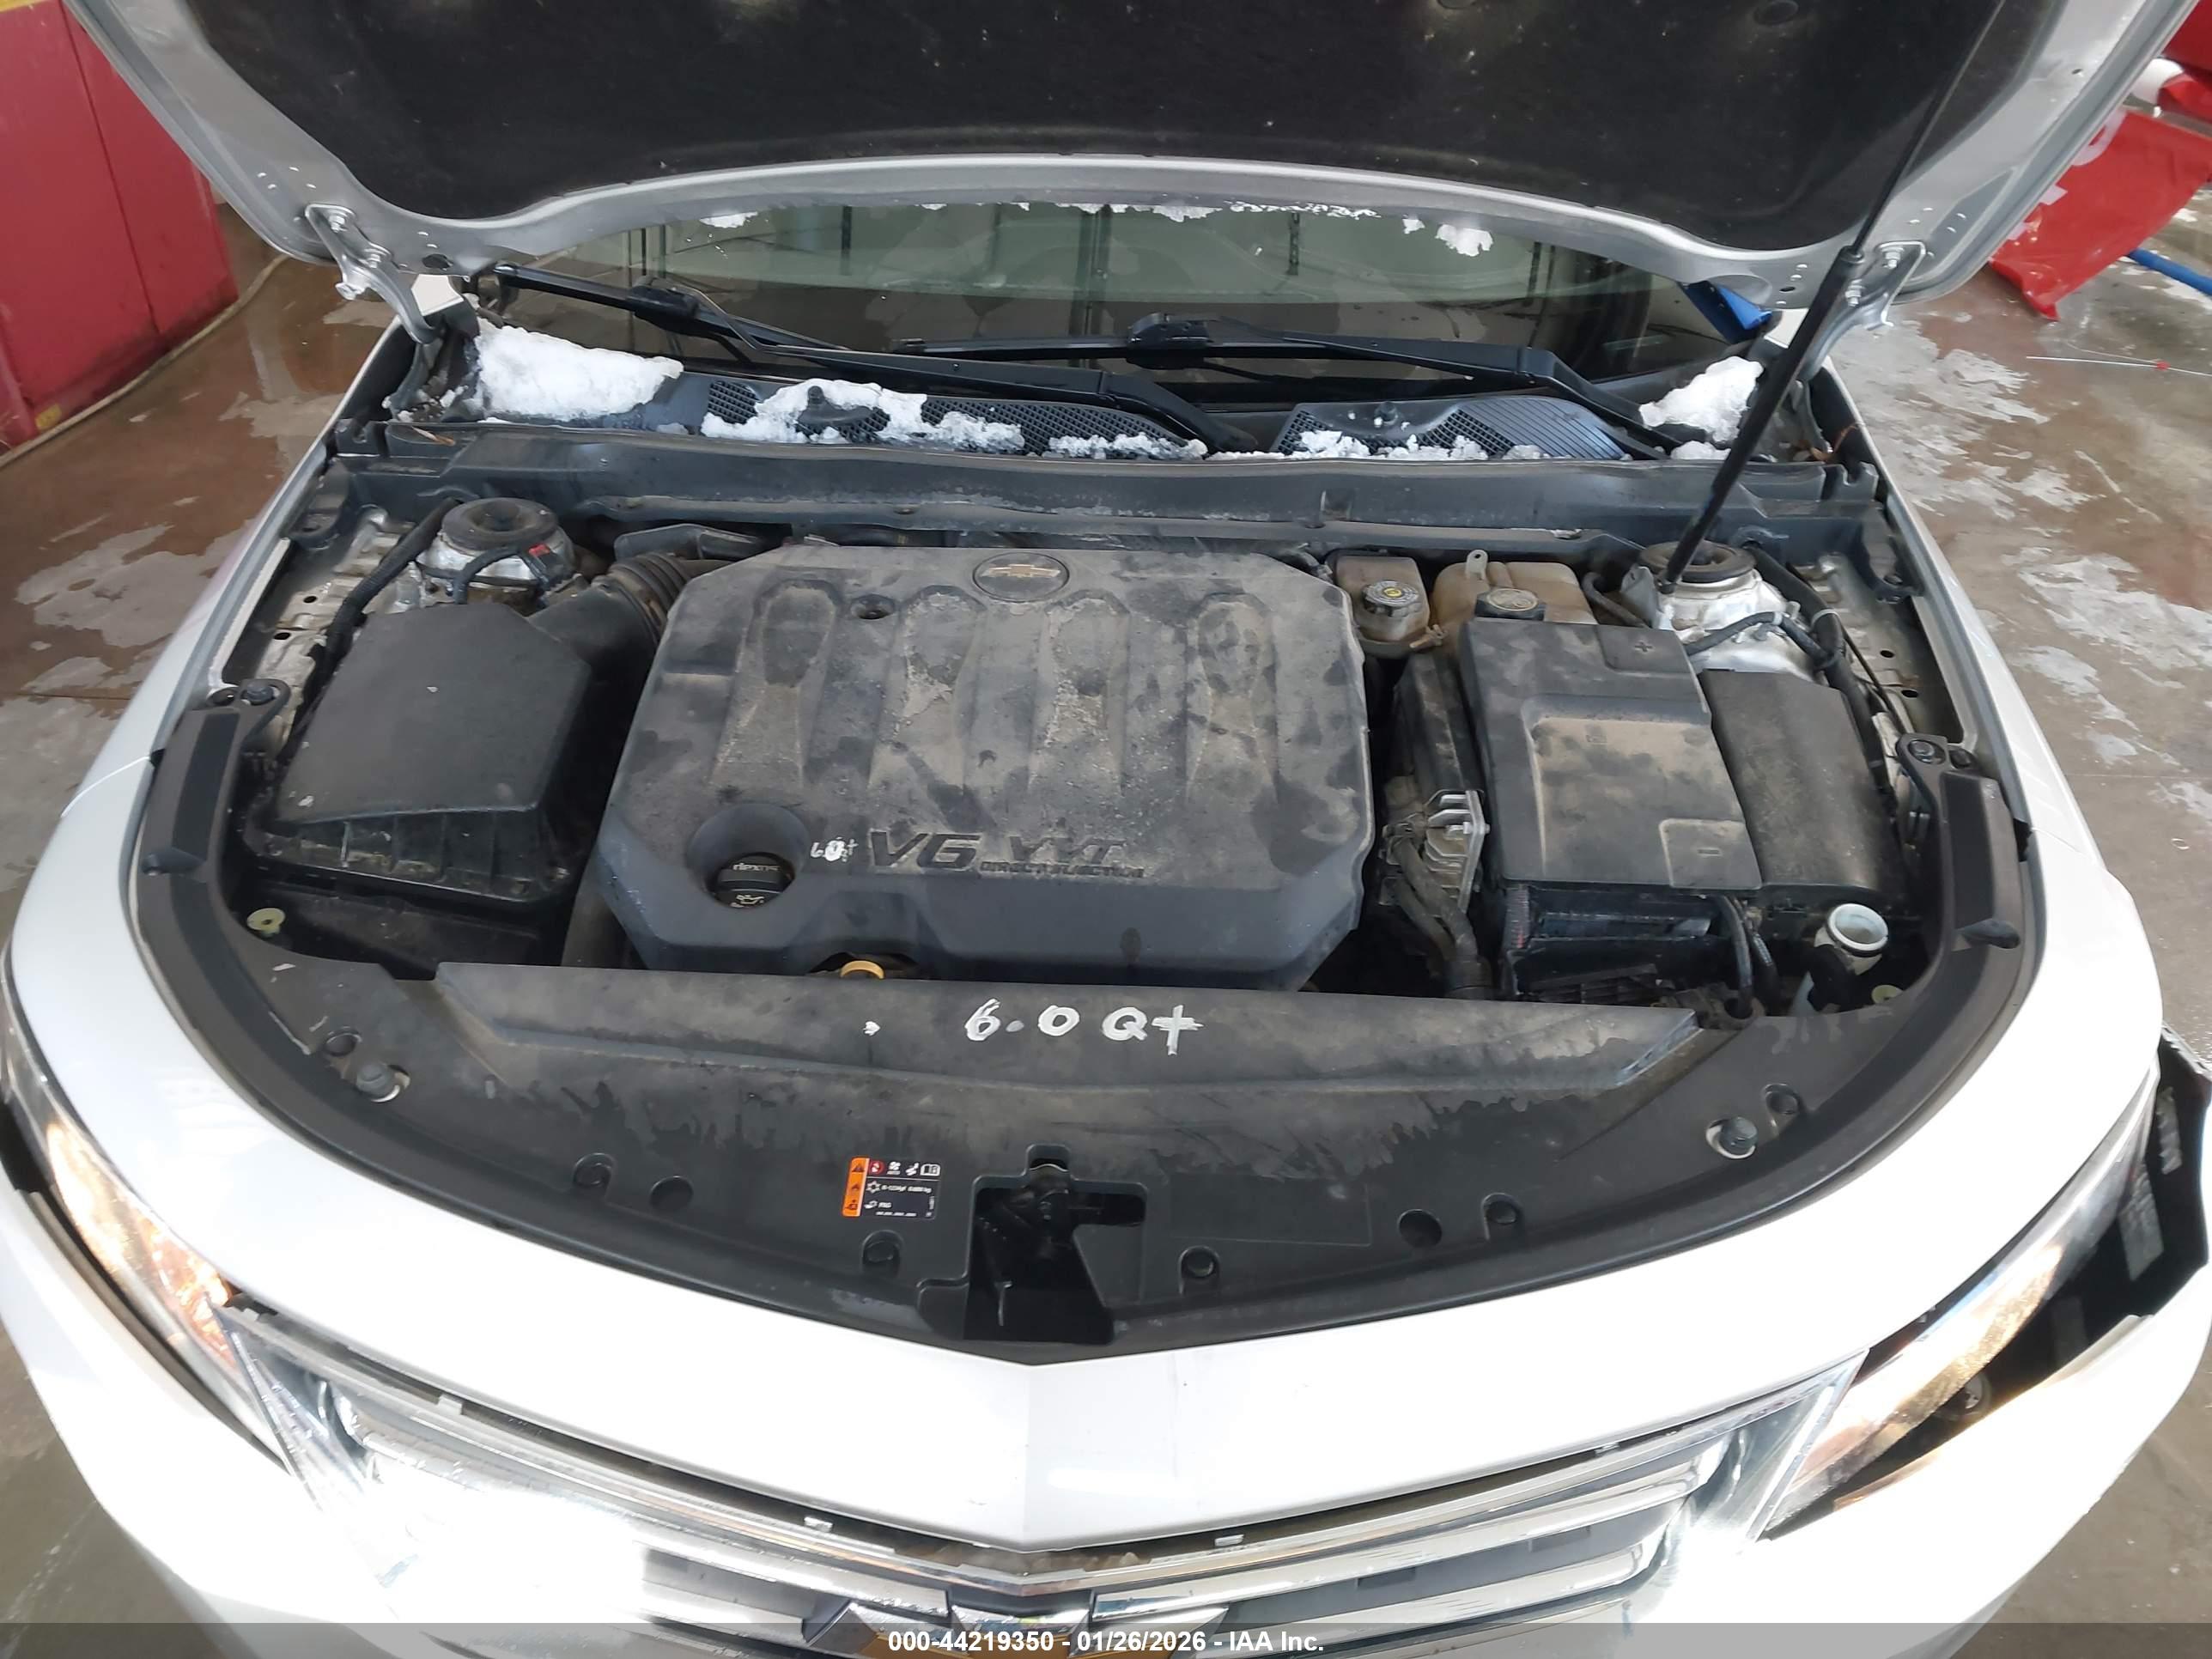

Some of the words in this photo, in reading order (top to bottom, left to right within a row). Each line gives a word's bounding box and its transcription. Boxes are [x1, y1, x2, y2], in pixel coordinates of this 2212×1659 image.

[870, 830, 981, 870] V6
[964, 998, 1080, 1042] 6.0
[1102, 1004, 1204, 1055] Qt
